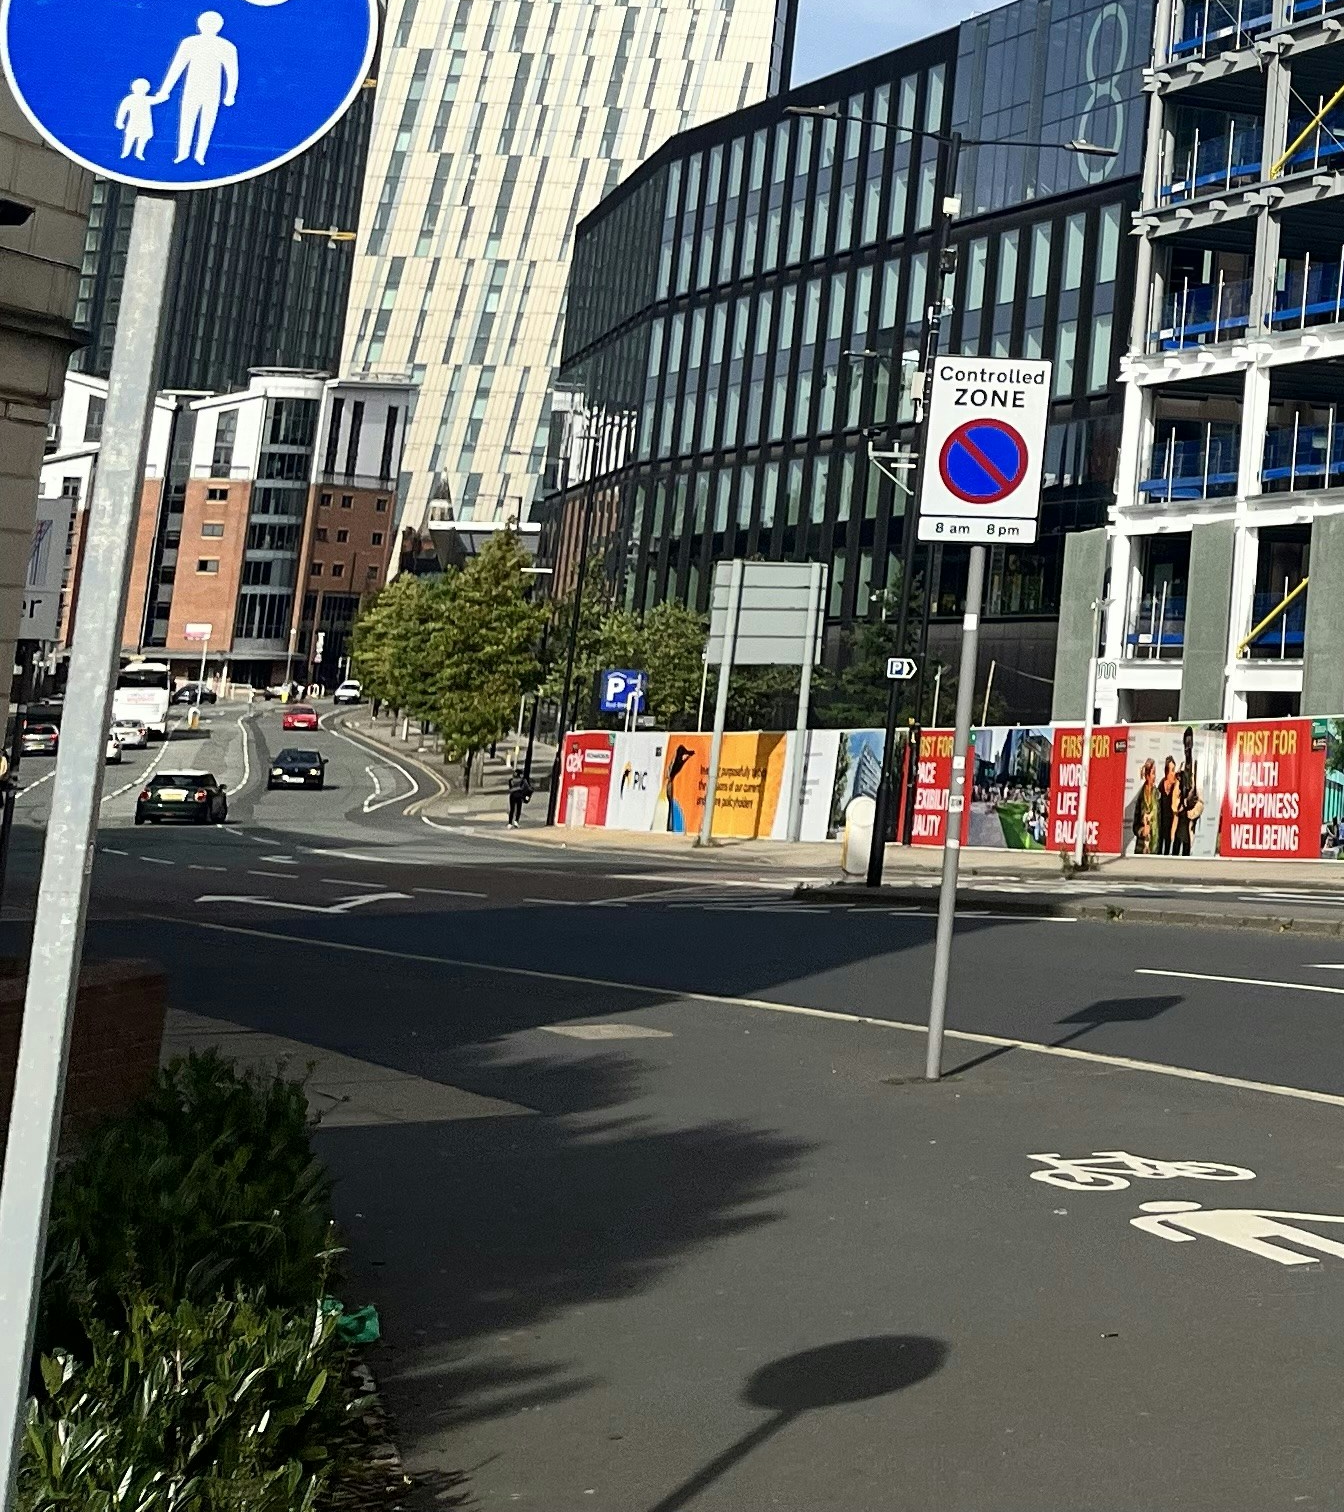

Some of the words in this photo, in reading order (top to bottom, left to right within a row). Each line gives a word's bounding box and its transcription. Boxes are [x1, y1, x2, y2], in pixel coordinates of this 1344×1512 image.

[940, 366, 1045, 385] Controlled
[954, 388, 1026, 408] ZONE
[935, 522, 944, 533] 8
[949, 524, 970, 534] am
[893, 661, 903, 675] P
[606, 677, 626, 701] P
[1236, 730, 1270, 756] FIRST
[1272, 730, 1297, 755] FOR
[633, 771, 648, 791] PIC
[1236, 761, 1279, 787] HEALTH
[1056, 792, 1078, 816] LIFE
[1232, 792, 1299, 819] HAPPINESS
[1231, 823, 1299, 851] WELLBEING
